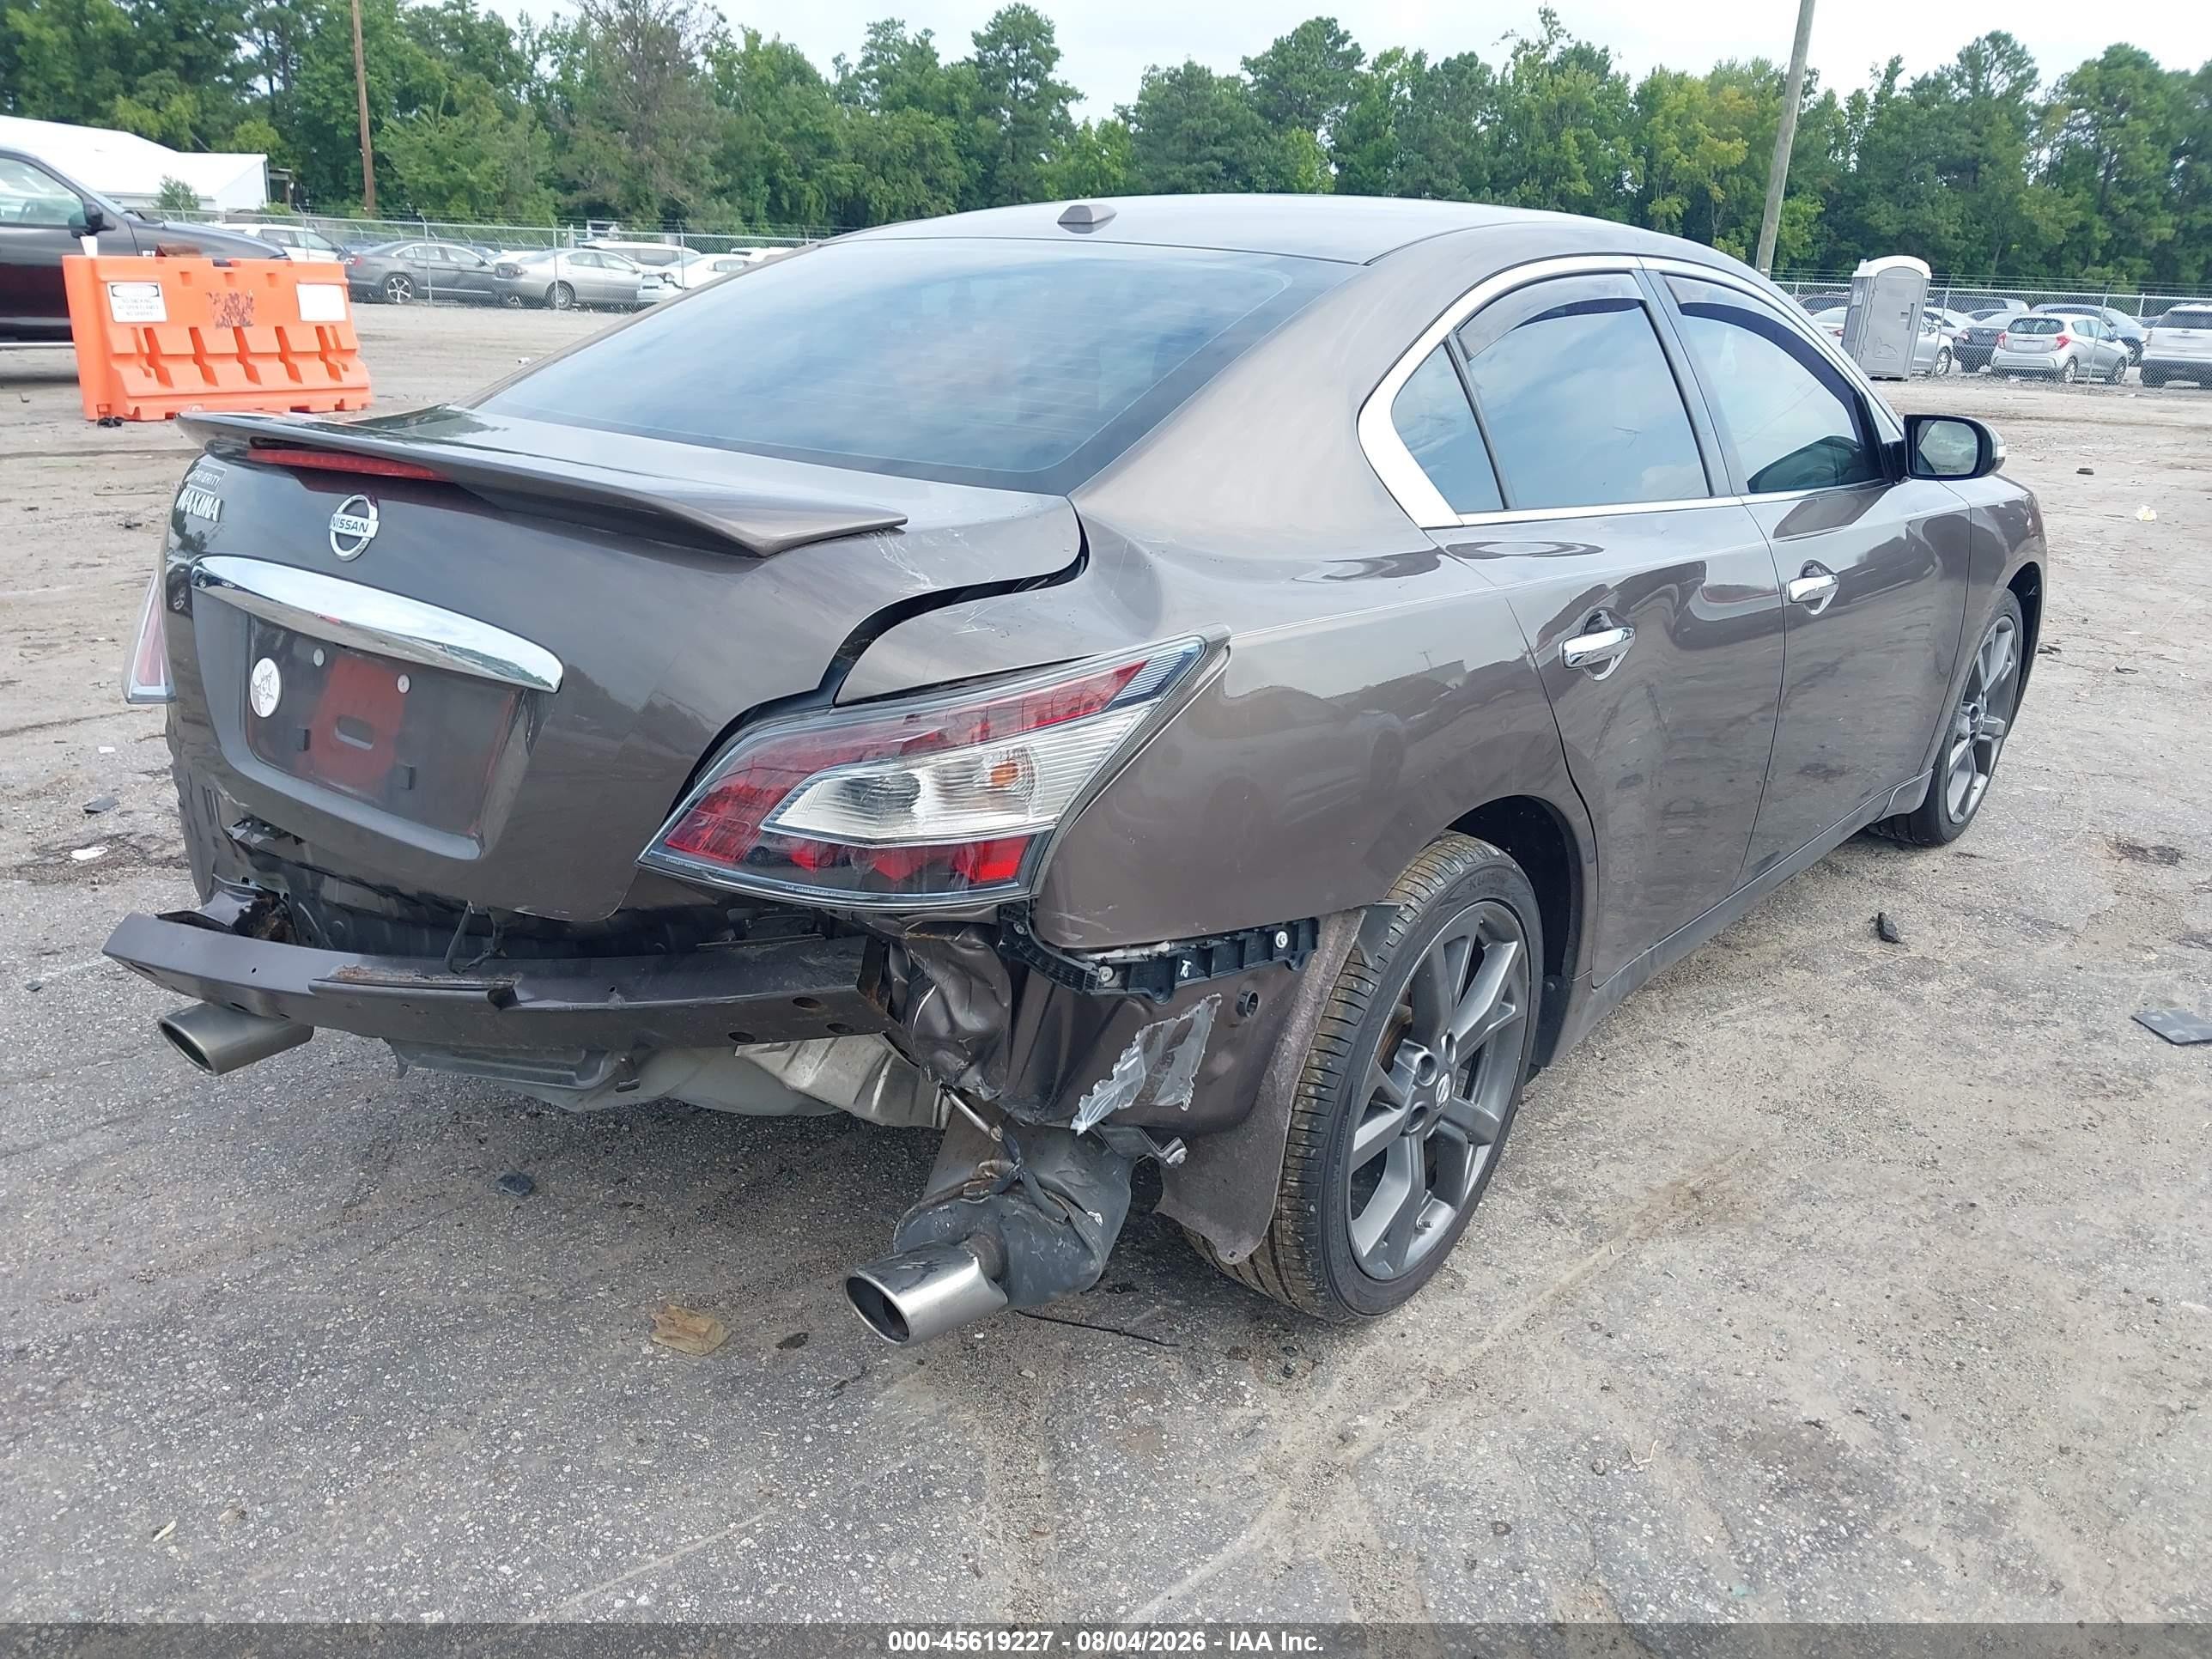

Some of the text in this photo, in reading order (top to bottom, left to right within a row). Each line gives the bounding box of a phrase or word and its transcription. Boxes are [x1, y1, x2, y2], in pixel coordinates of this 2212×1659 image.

[193, 469, 221, 487] PRIORITY
[176, 488, 221, 522] MAXIMA
[331, 516, 369, 533] NISSAN
